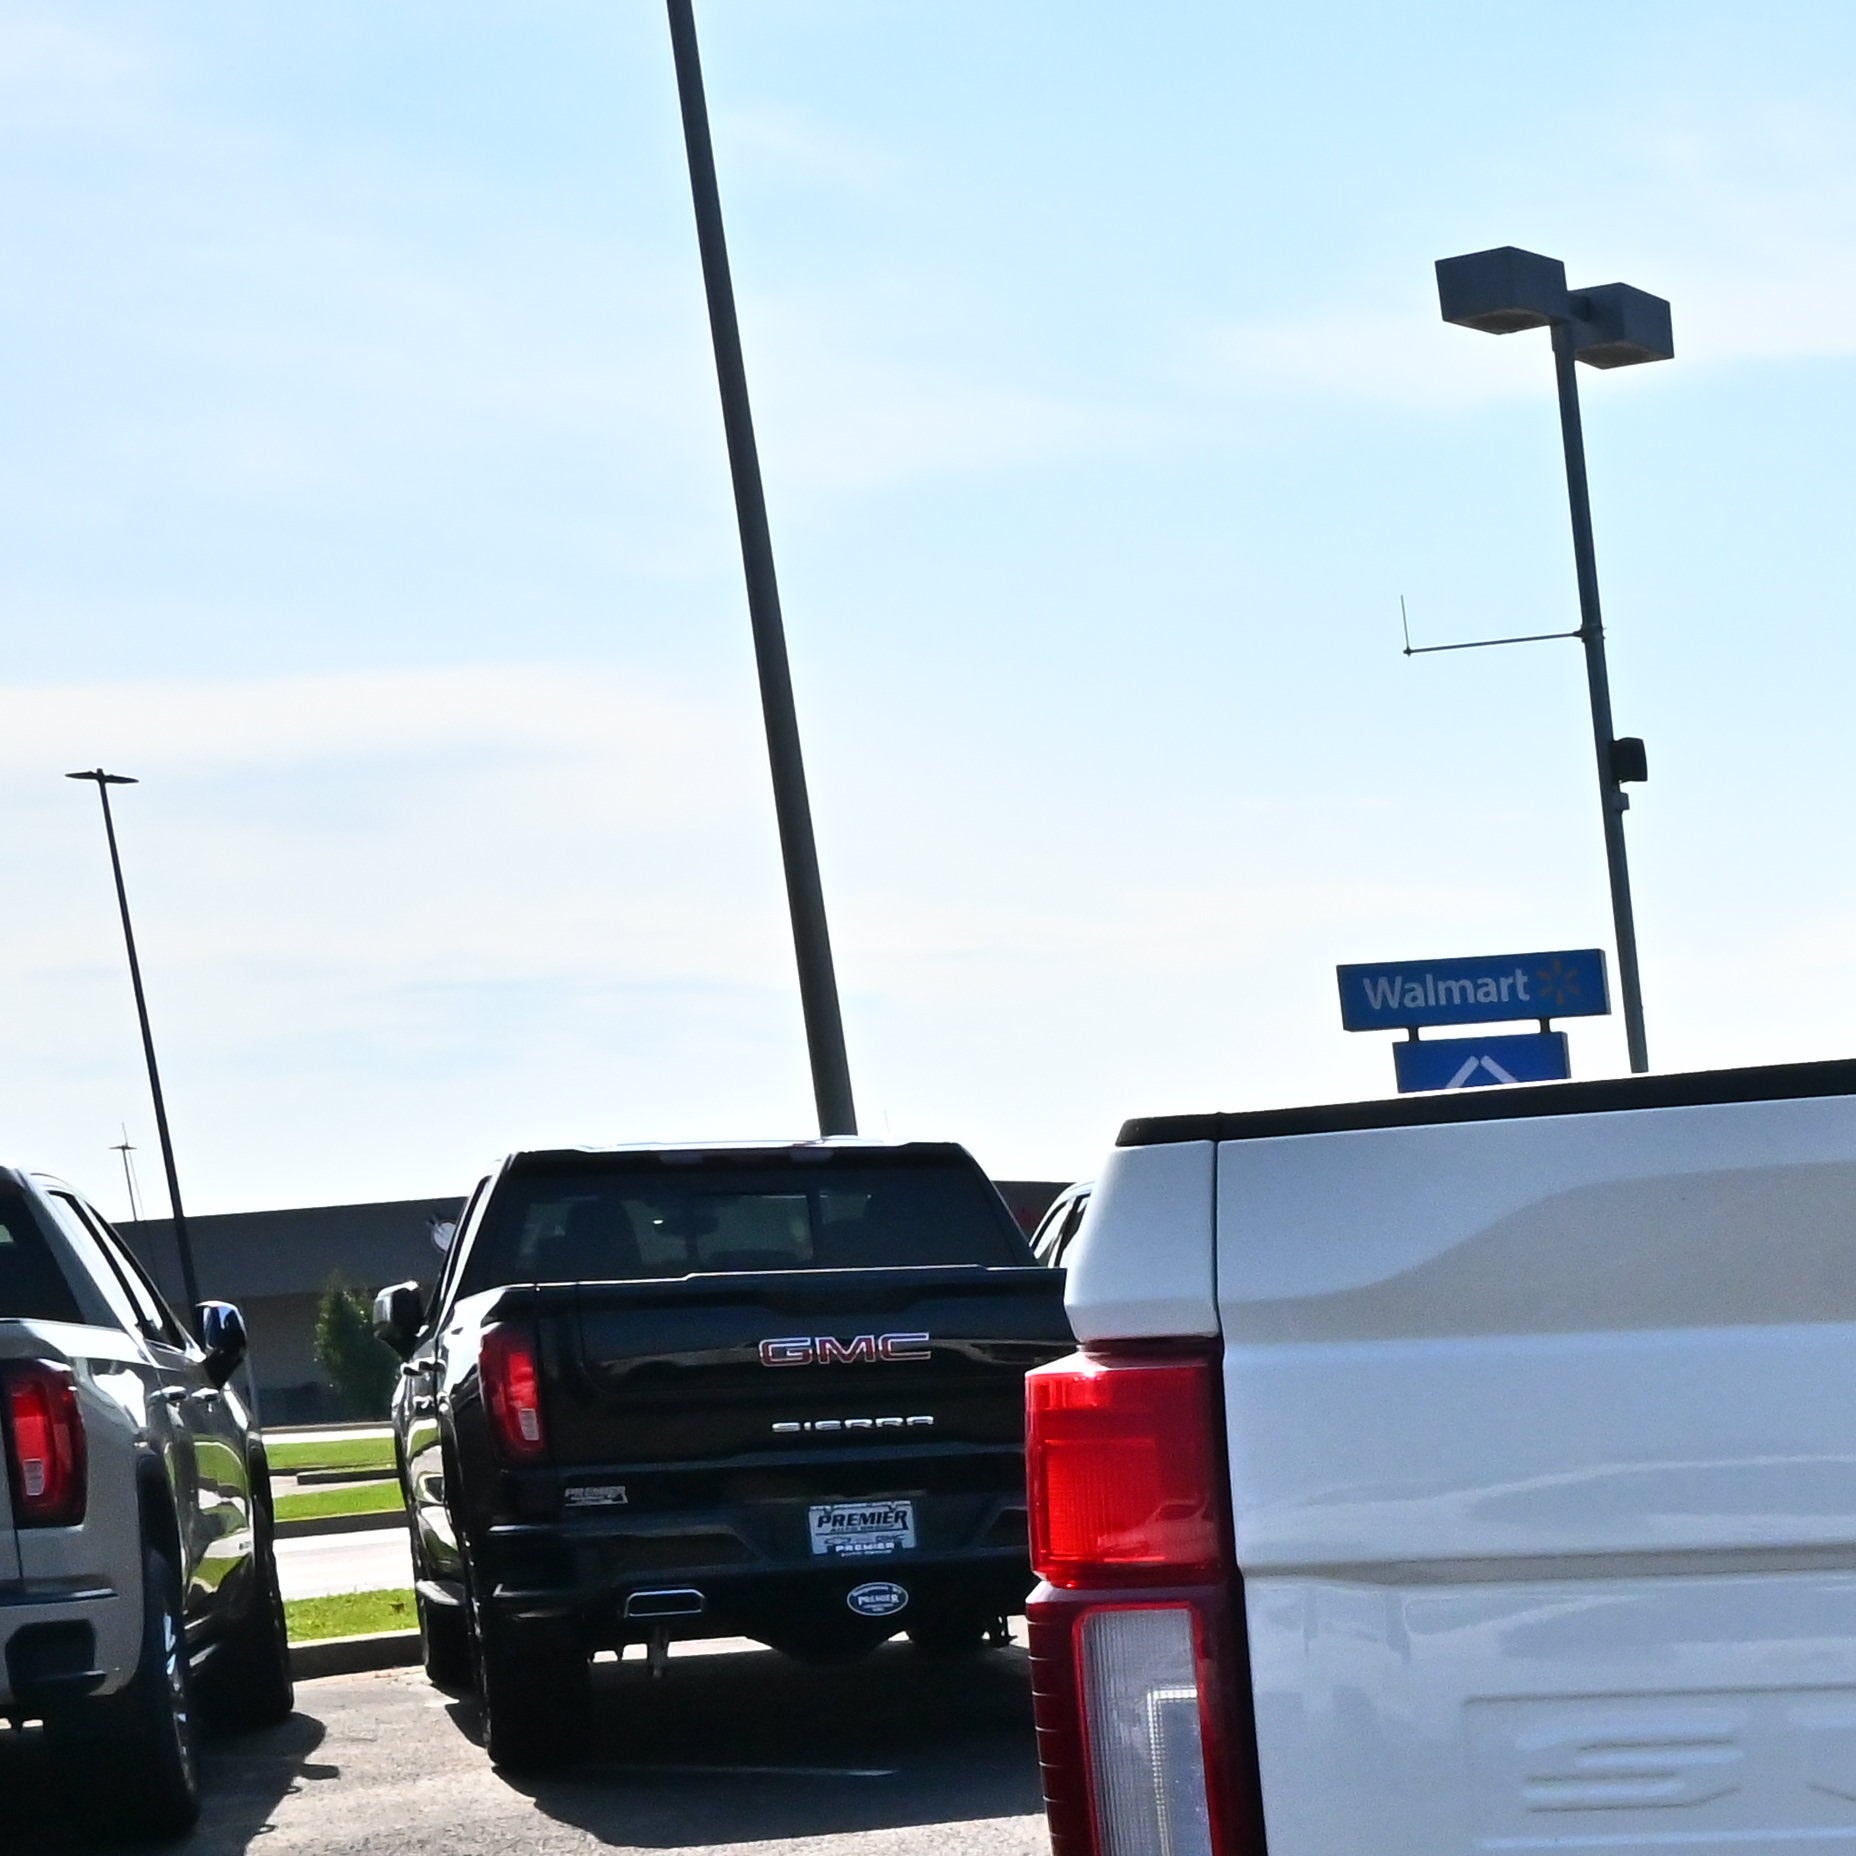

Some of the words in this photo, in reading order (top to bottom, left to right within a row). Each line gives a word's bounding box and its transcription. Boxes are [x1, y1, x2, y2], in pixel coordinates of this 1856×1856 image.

[1362, 968, 1531, 1011] Walmart
[759, 1333, 932, 1367] GMC
[771, 1415, 935, 1433] SIERRA
[817, 1510, 909, 1530] PREMIER
